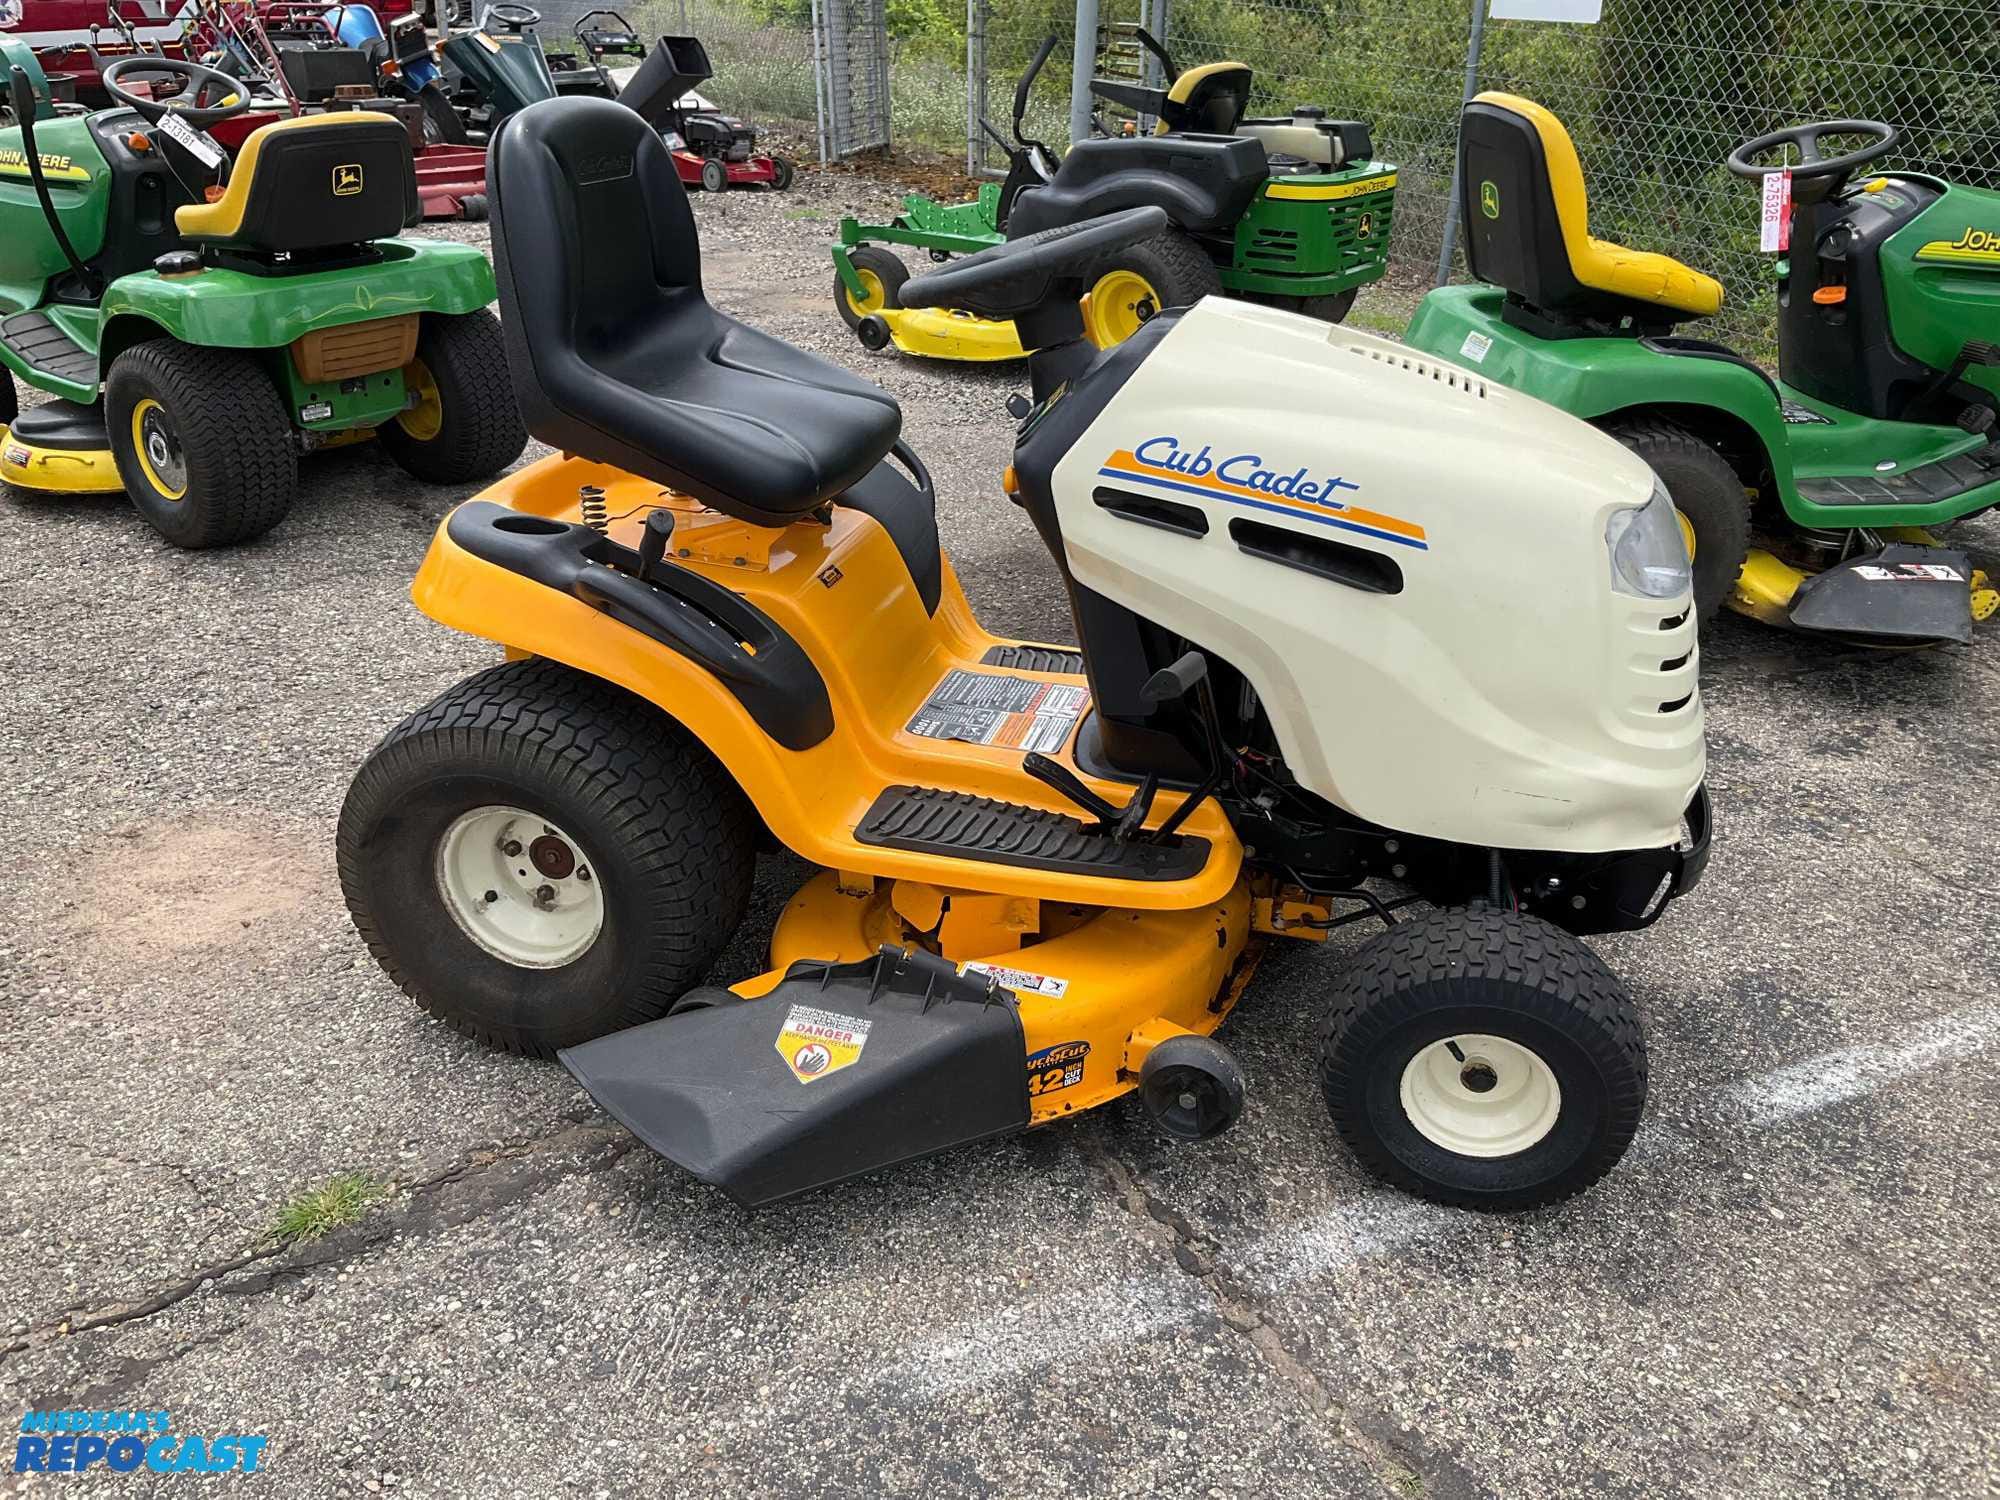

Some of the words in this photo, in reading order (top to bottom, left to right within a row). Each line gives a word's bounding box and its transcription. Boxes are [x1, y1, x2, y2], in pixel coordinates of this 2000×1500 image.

[161, 119, 195, 148] 2-13181
[1352, 185, 1368, 197] JOHN
[1368, 180, 1388, 193] DEERE
[1765, 176, 1780, 222] 2-75326
[1134, 436, 1213, 476] Cub
[1216, 454, 1361, 509] Cadet
[911, 718, 931, 735] 1000
[795, 1023, 853, 1042] DANGER
[1064, 1069, 1081, 1079] CUT
[1065, 1061, 1082, 1072] INCH
[1027, 1068, 1066, 1095] 42
[1064, 1075, 1081, 1087] DECK
